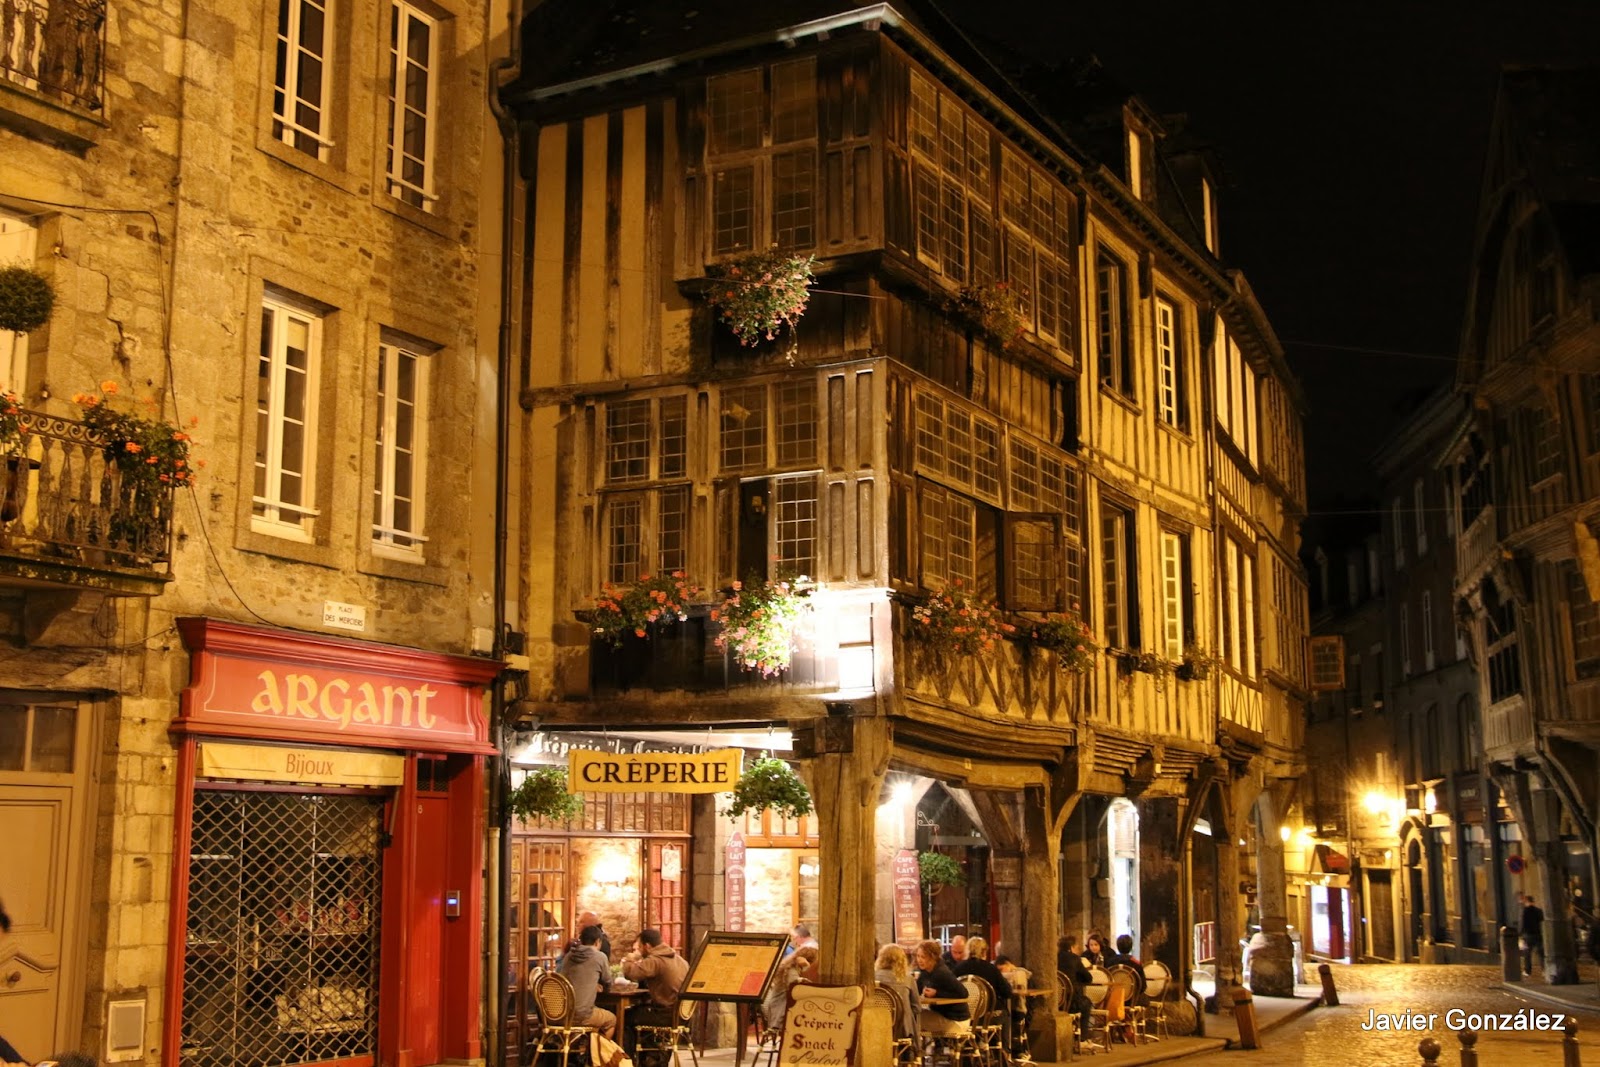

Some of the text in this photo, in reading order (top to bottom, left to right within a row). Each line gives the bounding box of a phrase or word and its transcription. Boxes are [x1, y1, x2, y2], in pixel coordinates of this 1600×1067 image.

[324, 614, 363, 627] DES MERCIERS
[286, 753, 334, 778] Bijoux
[582, 758, 728, 784] CRÊPERIE
[789, 1033, 835, 1051] Snack
